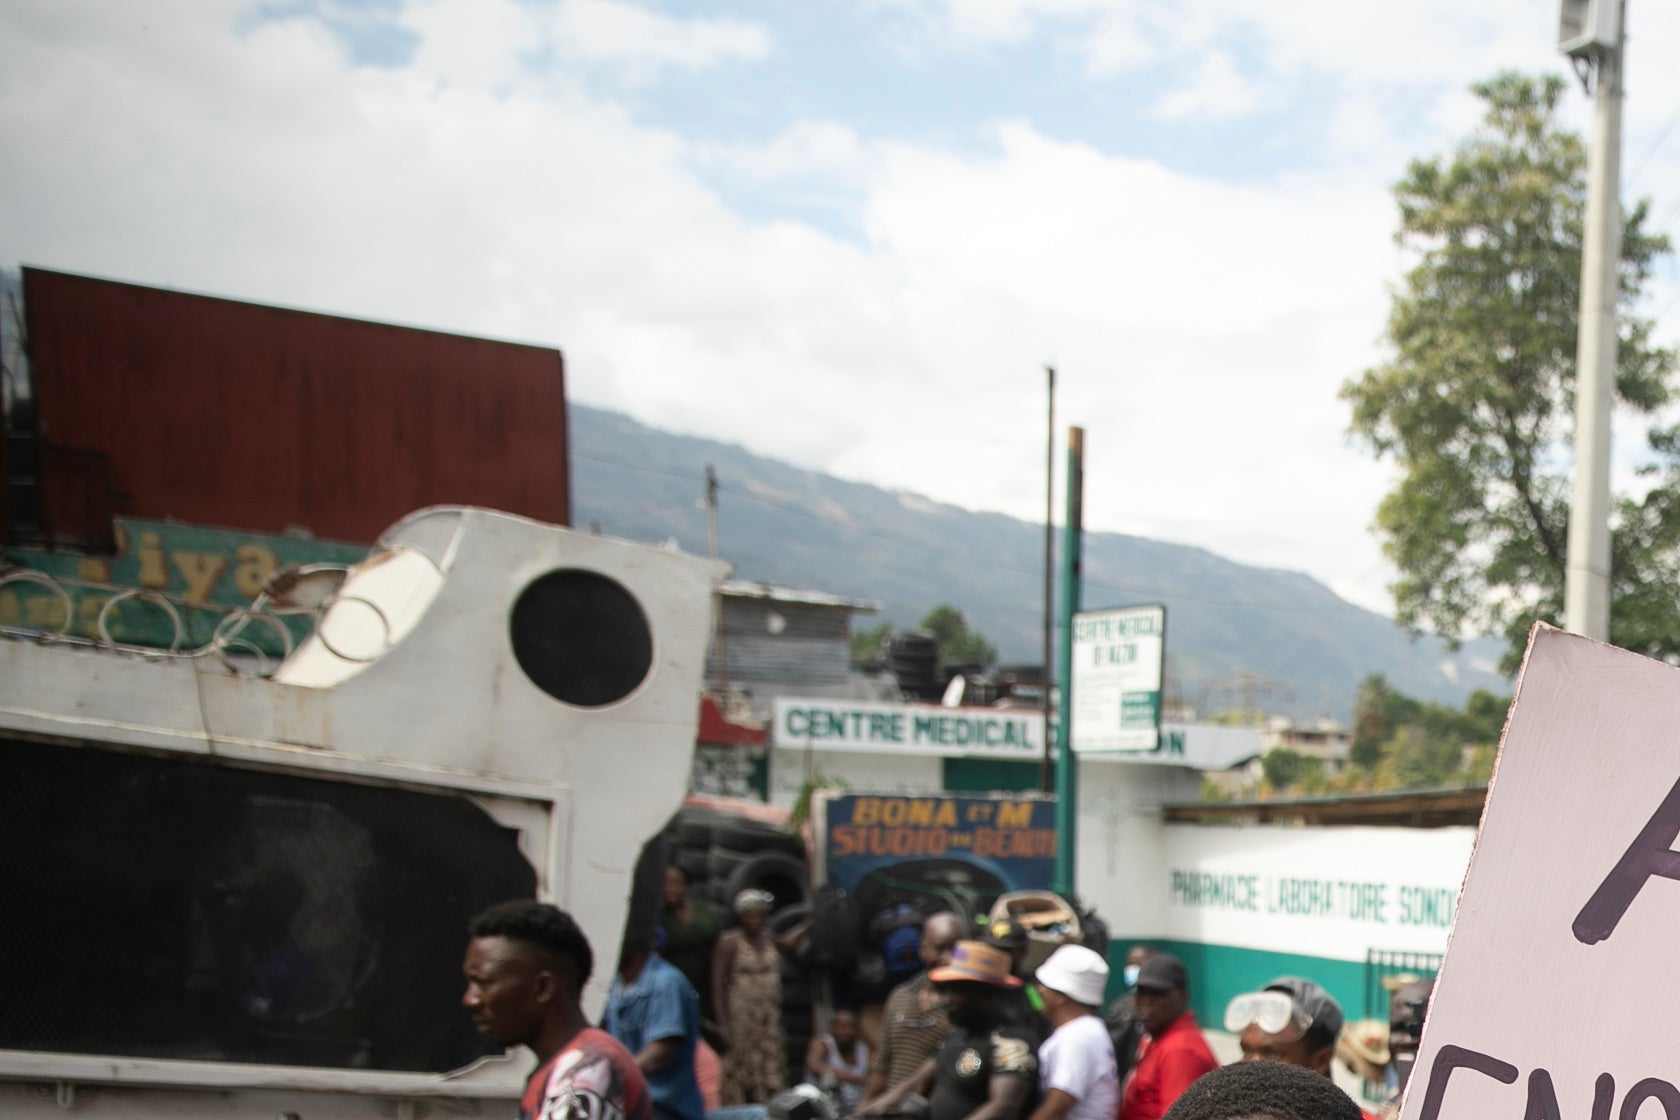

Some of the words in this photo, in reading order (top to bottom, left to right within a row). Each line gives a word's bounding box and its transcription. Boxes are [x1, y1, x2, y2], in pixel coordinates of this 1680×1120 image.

[787, 709, 902, 741] CENTRE
[912, 712, 1034, 749] MEDICAL
[852, 797, 958, 827] BONA
[831, 824, 947, 856] STUDIO
